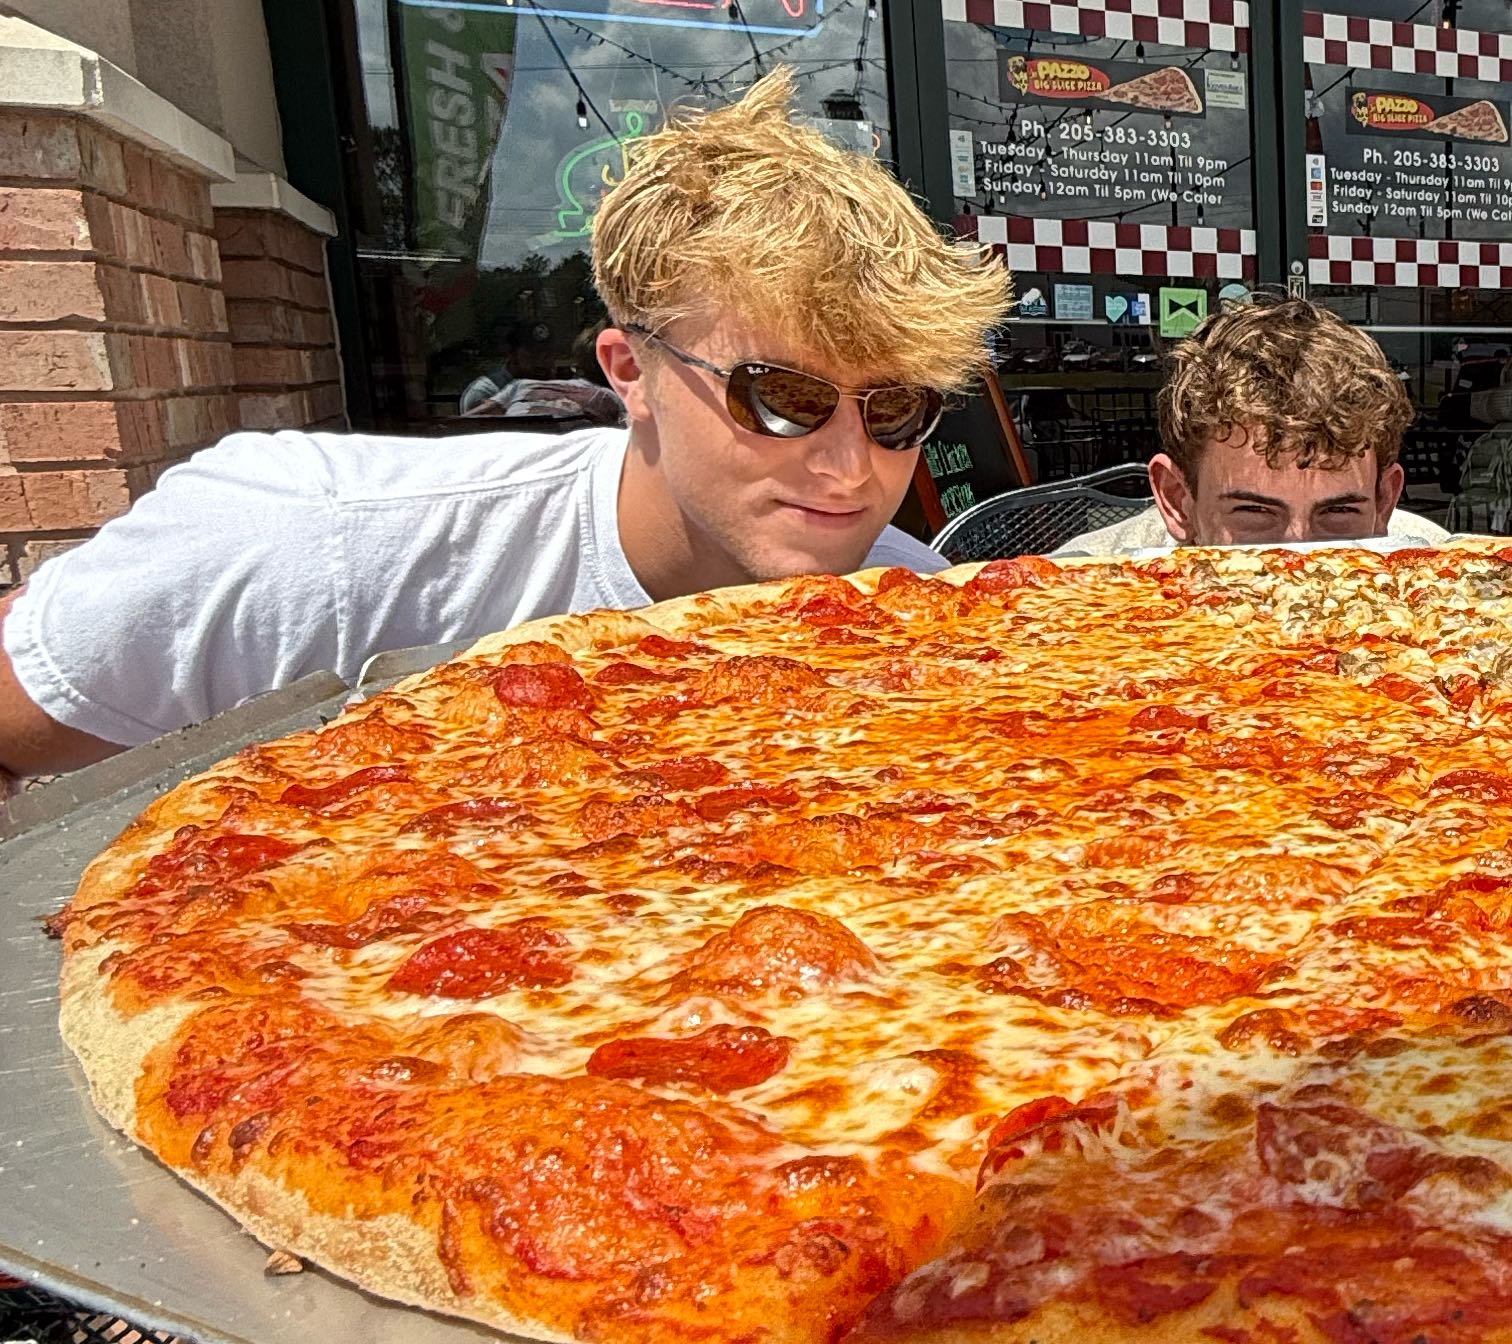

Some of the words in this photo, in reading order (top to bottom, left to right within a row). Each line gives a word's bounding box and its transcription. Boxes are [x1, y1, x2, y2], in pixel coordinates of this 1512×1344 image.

[1037, 61, 1090, 80] PAZZO
[1375, 96, 1419, 114] PAZZO
[1021, 119, 1052, 138] Ph.
[1060, 122, 1191, 149] 205-383-3303
[980, 140, 1045, 160] Tuesday
[1061, 146, 1128, 166] Thursday
[1135, 151, 1174, 167] 11am
[1178, 154, 1193, 168] Til
[1197, 156, 1227, 172] 9pm
[1363, 148, 1388, 165] Ph.
[1393, 150, 1500, 172] 205-383-3303
[985, 159, 1033, 177] Friday
[1050, 164, 1118, 183] Saturday
[1124, 168, 1163, 184] 11am
[1167, 171, 1182, 185] Til
[1187, 172, 1225, 188] 10pm
[1330, 167, 1382, 184] Tuesday
[1395, 171, 1449, 188] Thursday
[1453, 175, 1485, 188] 11am
[1488, 177, 1500, 190] Til
[983, 177, 1042, 196] Sunday
[1048, 181, 1089, 196] 12am
[1093, 184, 1109, 197] Til
[1114, 186, 1145, 201] 5pm
[1333, 184, 1373, 200] Friday
[1385, 187, 1440, 203] Saturday
[1445, 191, 1476, 204] 11am
[1480, 192, 1491, 205] Til
[1332, 200, 1379, 216] Sunday
[1384, 203, 1417, 216] 12am
[1420, 205, 1432, 216] Til
[1436, 206, 1462, 221] 5pm
